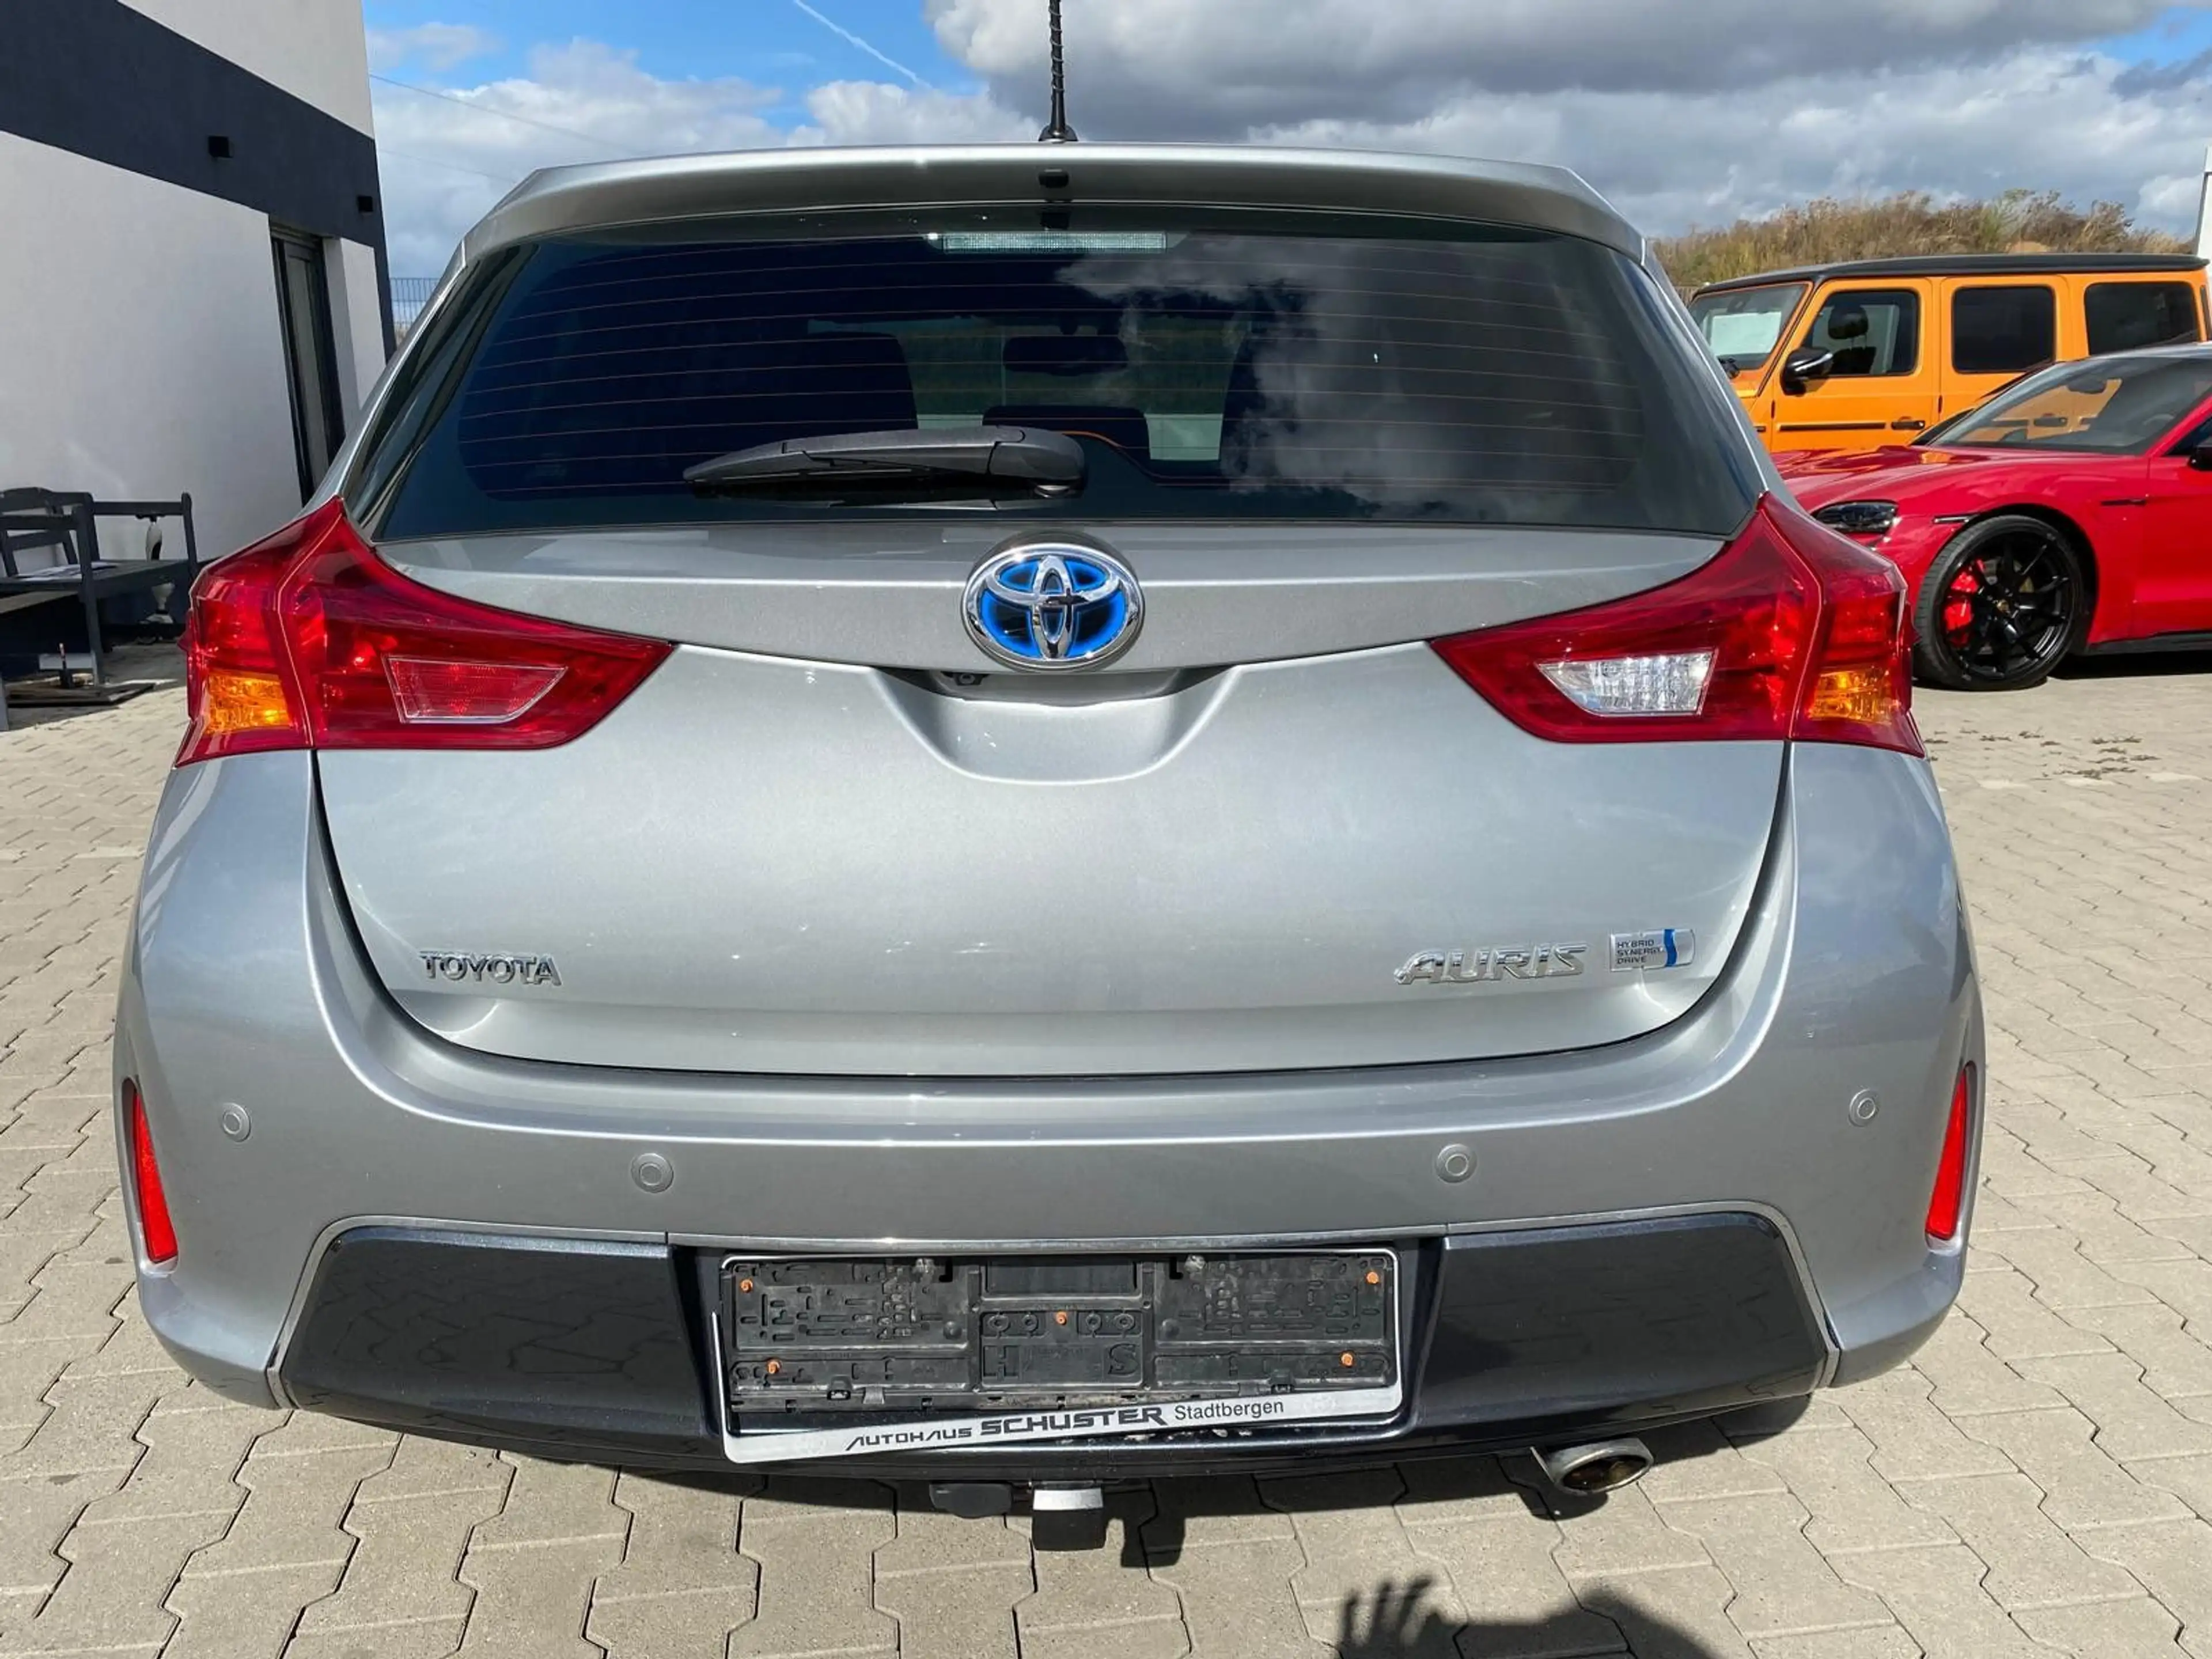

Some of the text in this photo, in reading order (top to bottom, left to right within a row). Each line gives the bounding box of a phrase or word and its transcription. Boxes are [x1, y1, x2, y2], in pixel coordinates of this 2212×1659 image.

[1617, 956, 1646, 964] DRIVE
[1618, 939, 1654, 948] HYBRID
[419, 950, 562, 986] TOYOTA
[1393, 942, 1588, 984] AURIS
[846, 1399, 1285, 1451] AUTOHAUS SCHUSTER Stadtbergen
